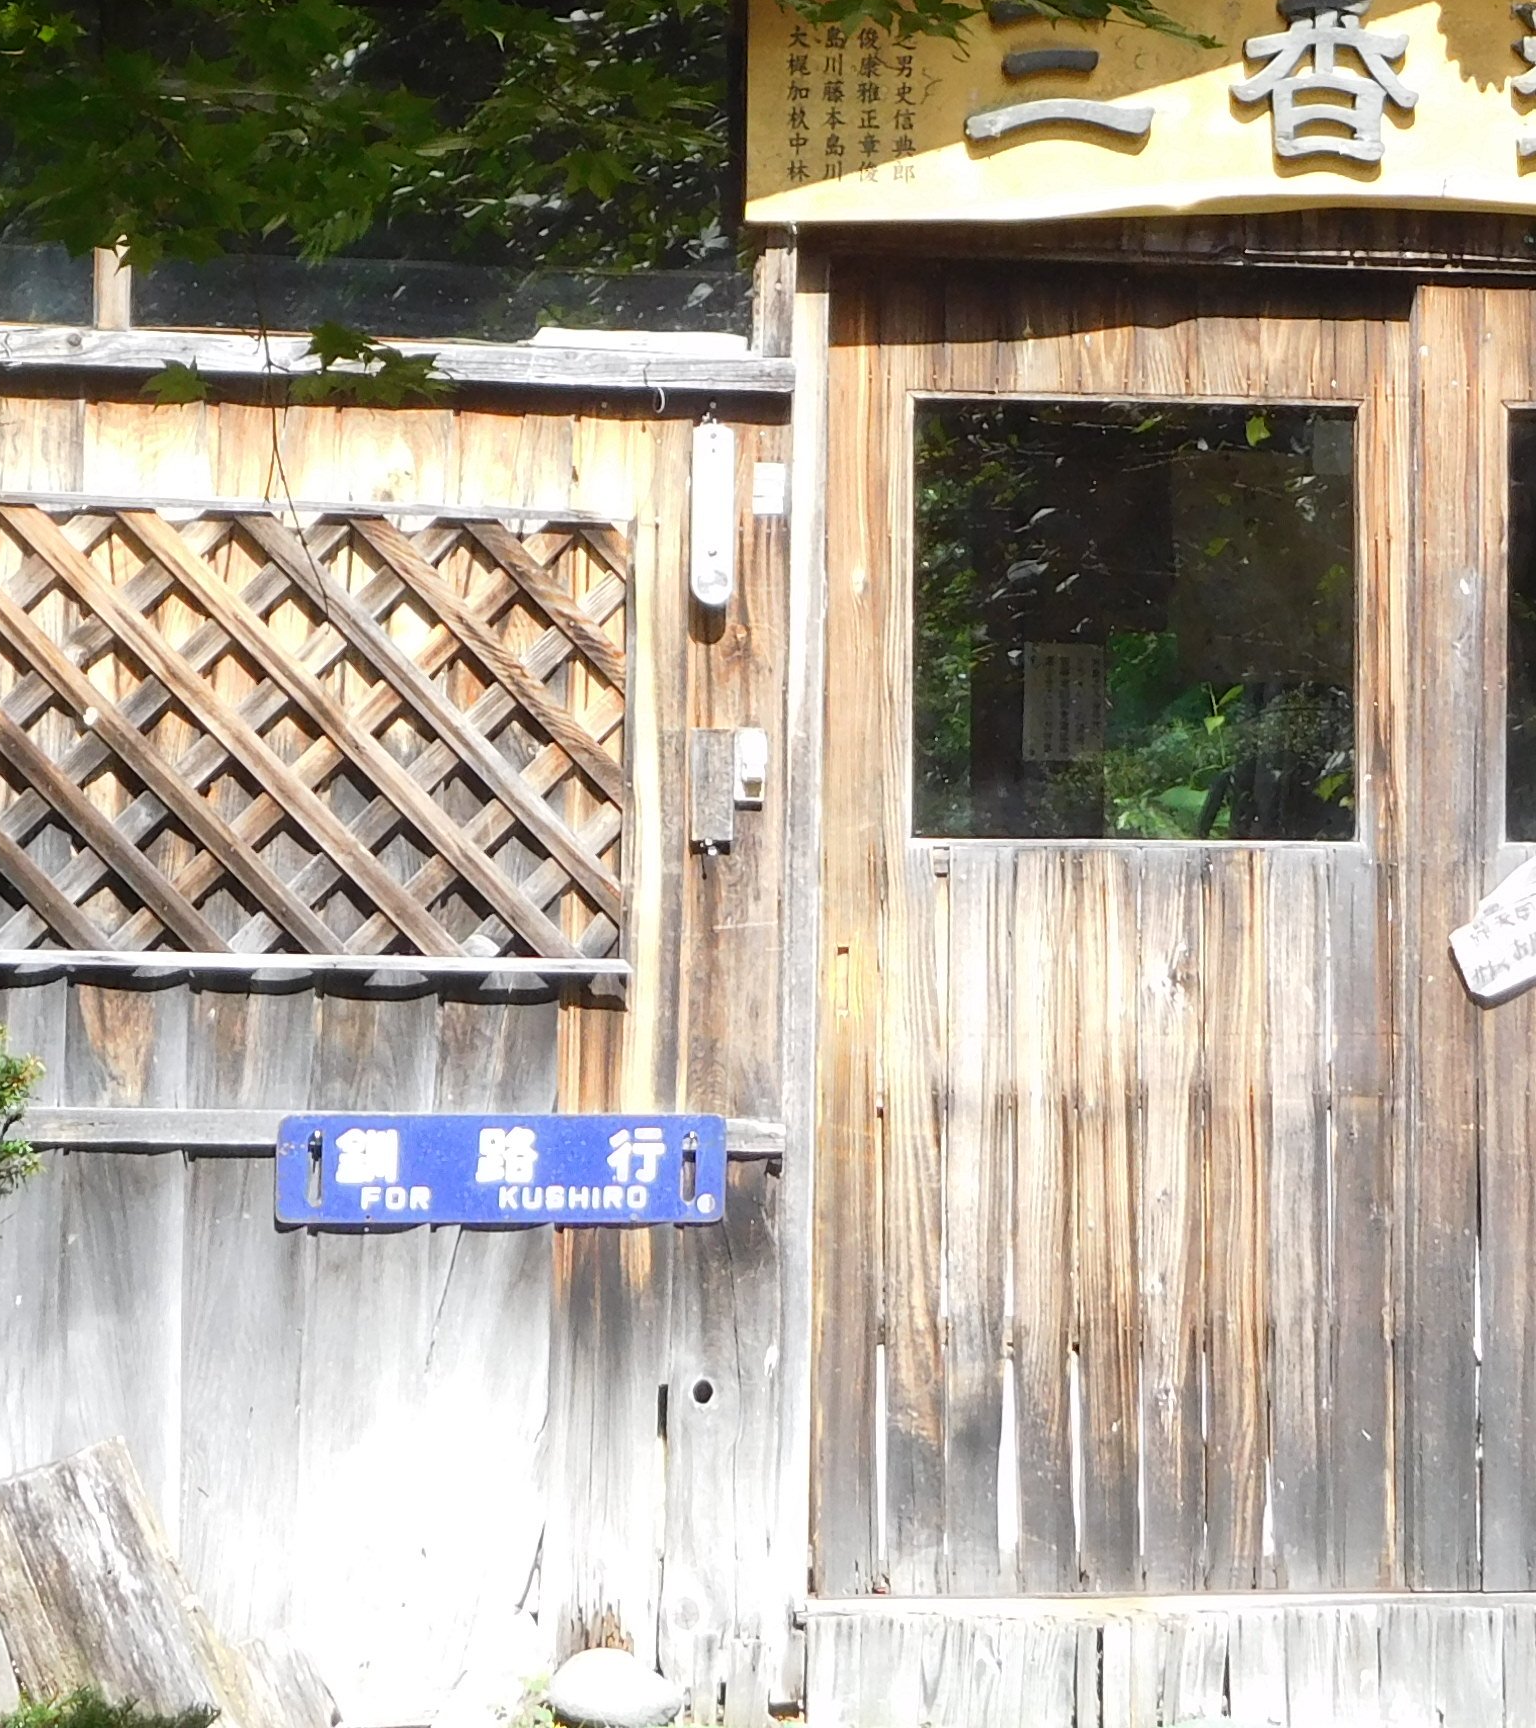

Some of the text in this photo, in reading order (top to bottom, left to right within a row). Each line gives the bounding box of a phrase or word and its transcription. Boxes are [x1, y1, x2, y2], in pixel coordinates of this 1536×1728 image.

[335, 1126, 666, 1184] 釧路行
[360, 1185, 648, 1211] FOR KUSHIRO
